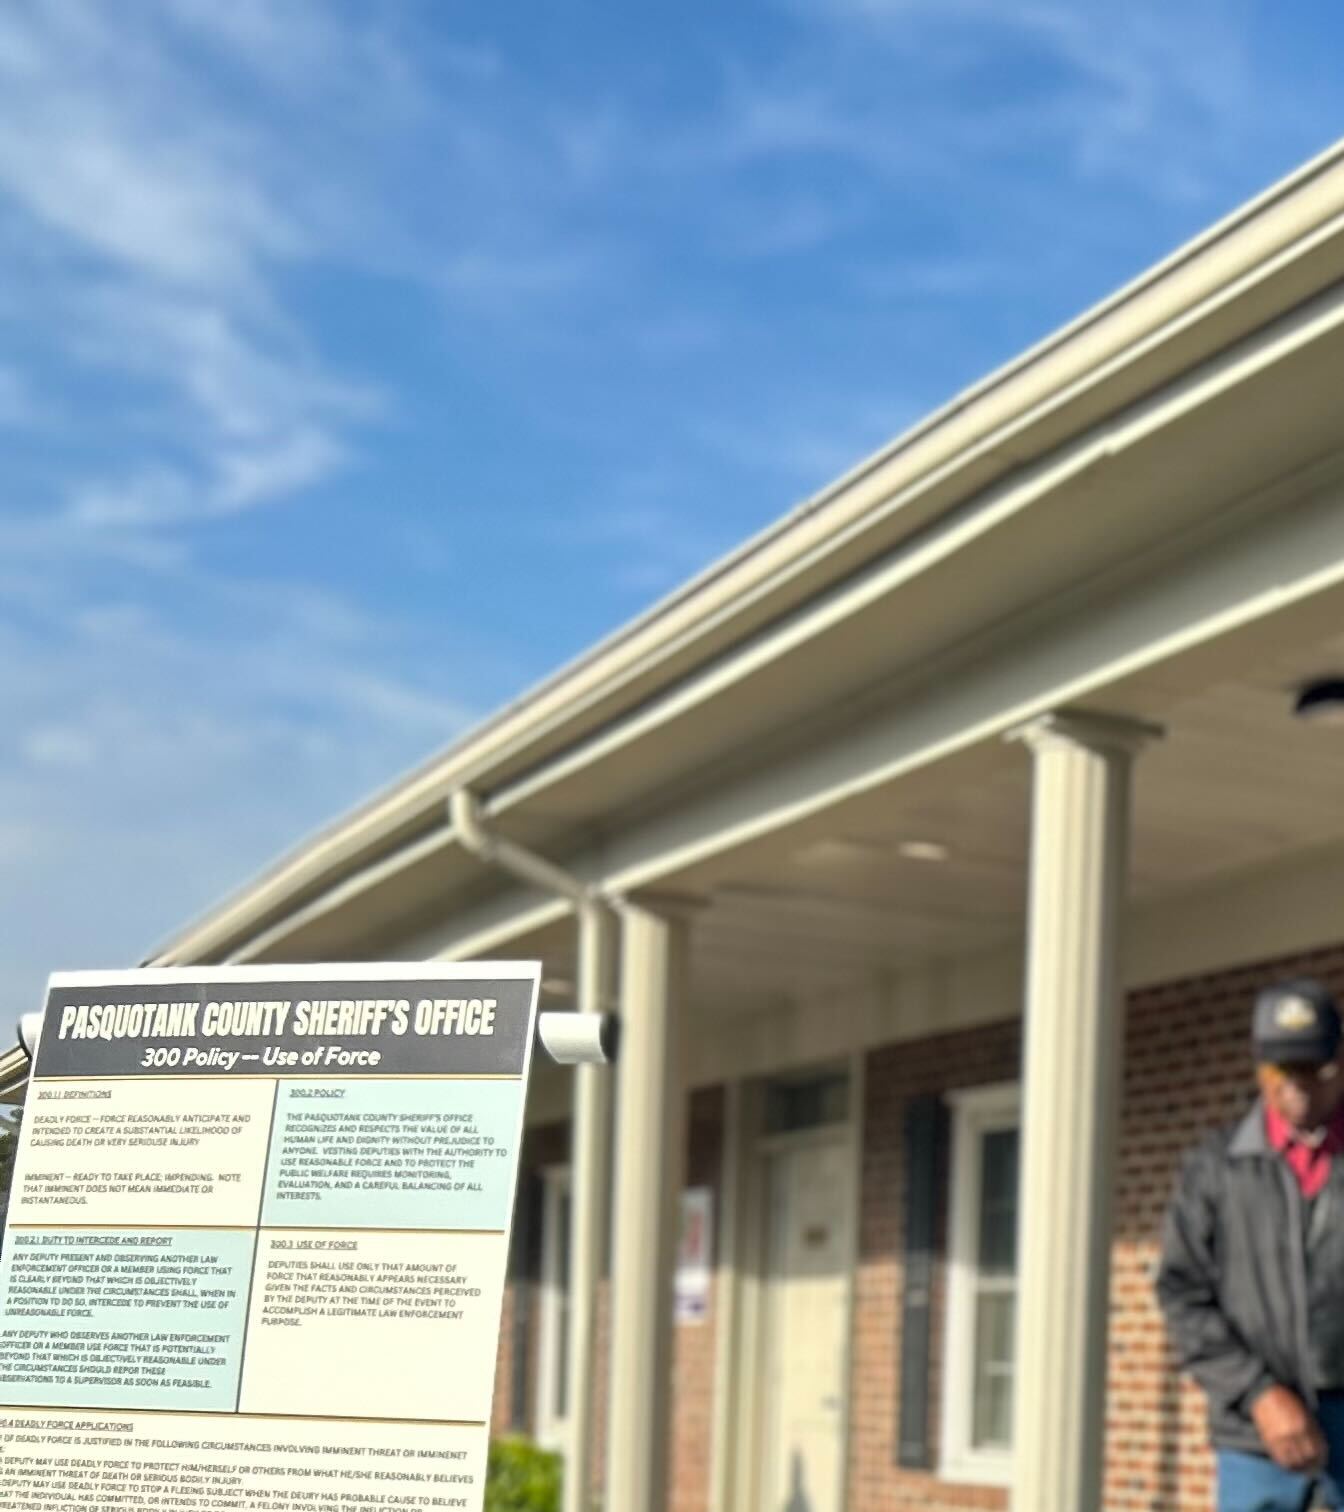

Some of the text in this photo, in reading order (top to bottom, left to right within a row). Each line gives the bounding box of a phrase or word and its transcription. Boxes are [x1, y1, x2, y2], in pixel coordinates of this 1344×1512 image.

[58, 999, 498, 1041] PASQUOTANK COUNTY SHERIFF'S OFFICE
[141, 1047, 181, 1067] 300
[182, 1046, 240, 1070] Policy
[263, 1047, 299, 1066] Use
[301, 1047, 324, 1066] of
[324, 1047, 382, 1066] Force
